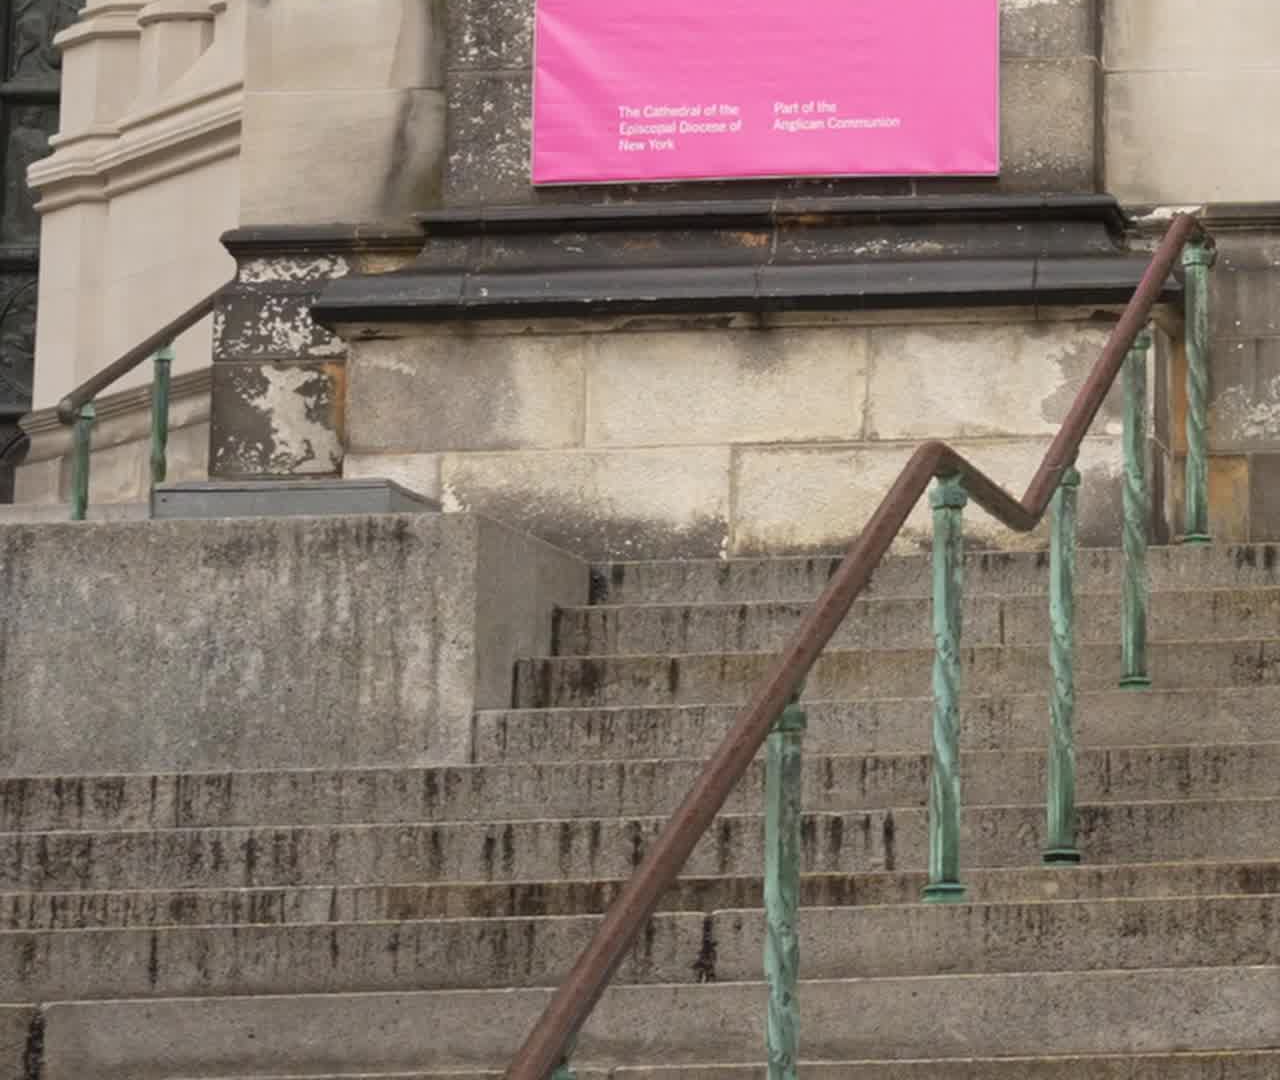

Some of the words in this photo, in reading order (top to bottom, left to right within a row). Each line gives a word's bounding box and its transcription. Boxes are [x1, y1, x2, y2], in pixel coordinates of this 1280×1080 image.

[618, 105, 641, 119] The
[643, 104, 702, 119] Cathedral
[704, 103, 717, 117] of
[719, 103, 740, 117] the
[773, 100, 800, 115] Part
[801, 100, 815, 113] of
[816, 99, 837, 113] the
[619, 120, 677, 137] Episcopal
[679, 119, 727, 134] Diocese
[729, 117, 742, 132] of
[773, 118, 826, 134] Anglican
[827, 116, 902, 130] Communion
[618, 139, 646, 152] New
[648, 137, 675, 152] York
